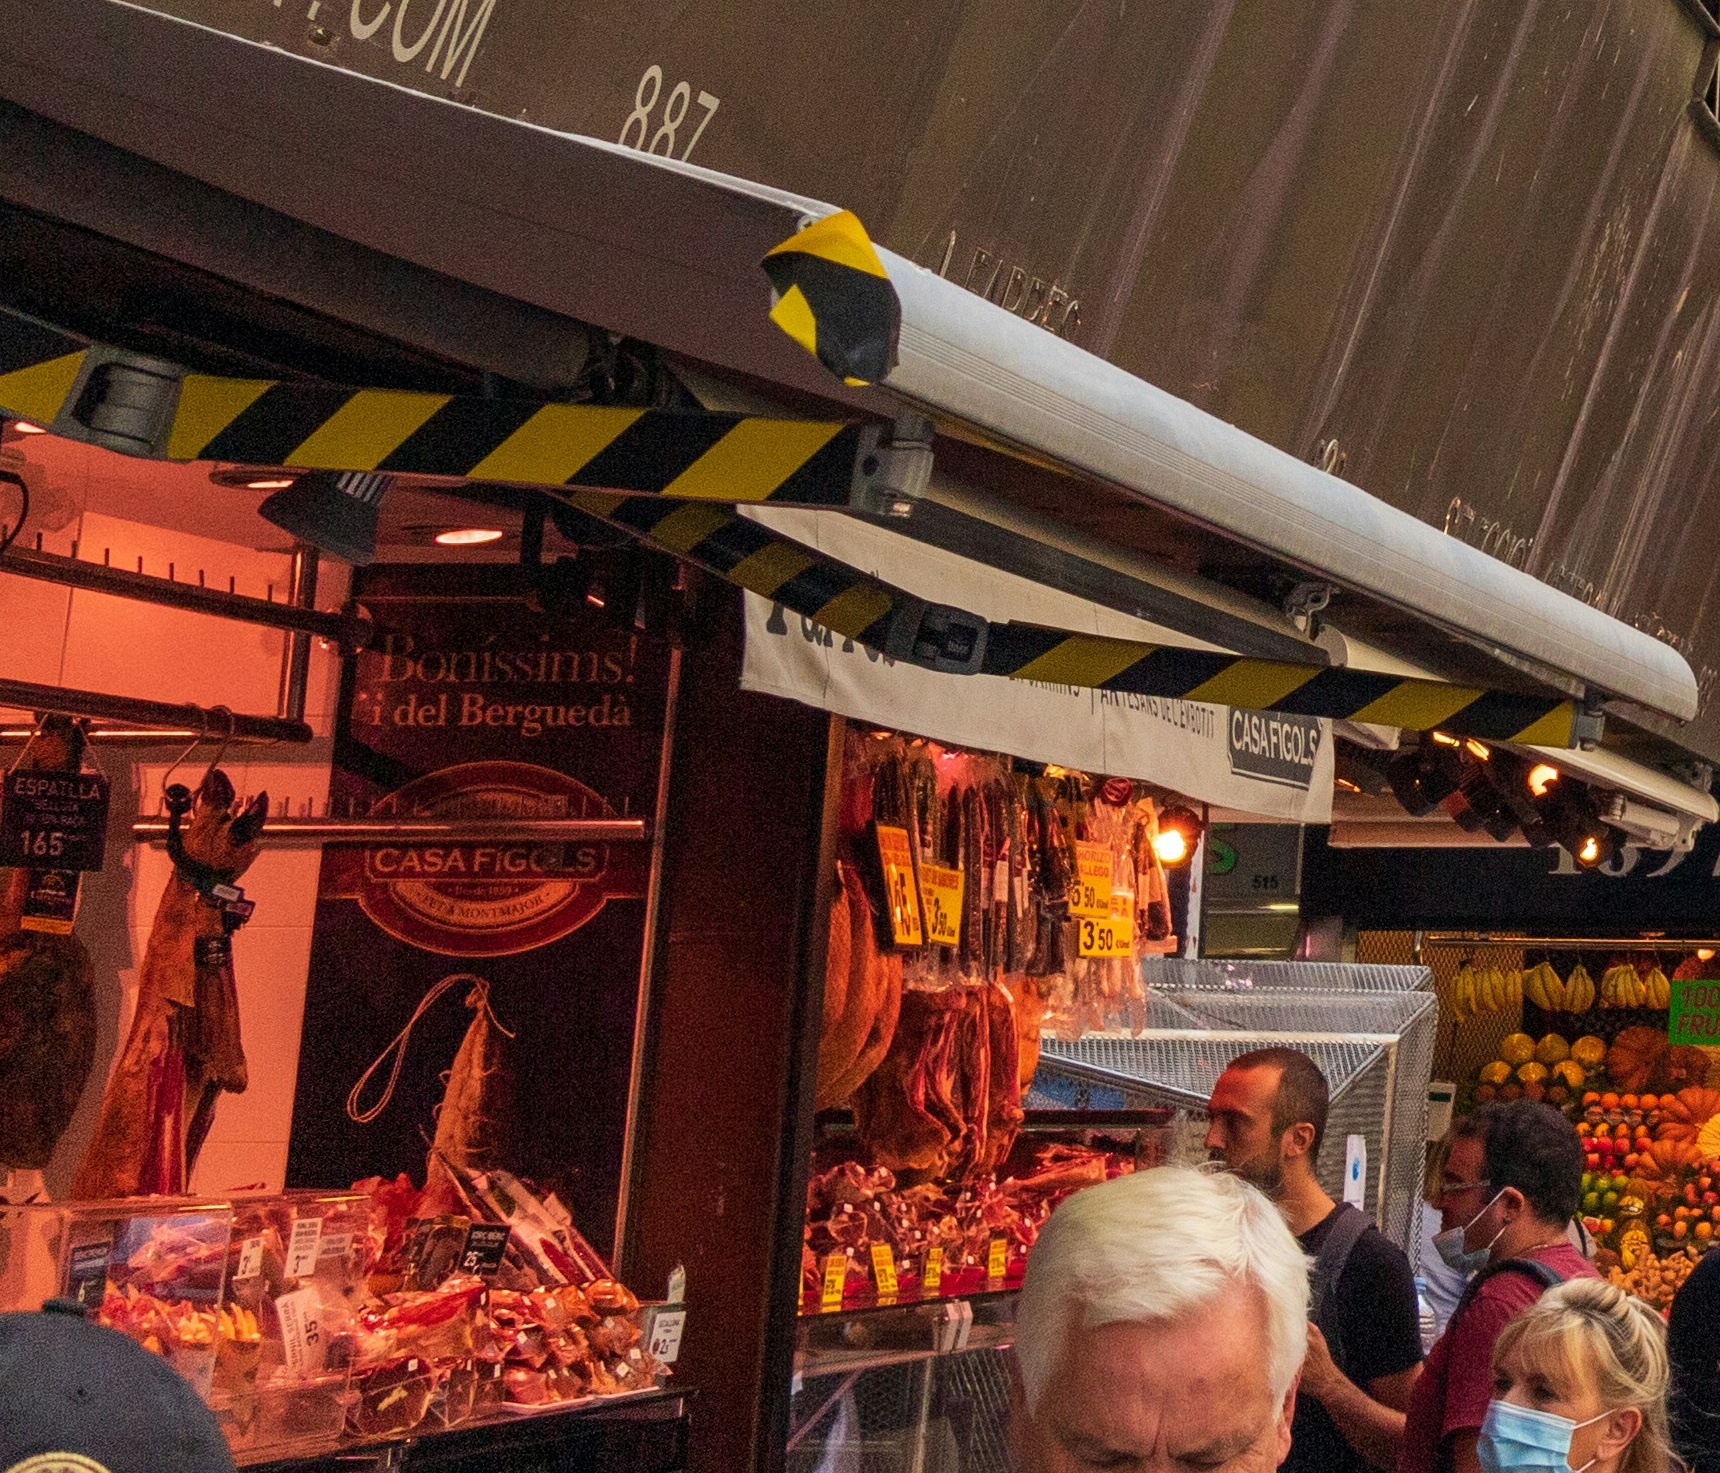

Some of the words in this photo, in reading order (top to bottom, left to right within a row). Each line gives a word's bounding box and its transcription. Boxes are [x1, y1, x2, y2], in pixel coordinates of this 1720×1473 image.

[620, 65, 721, 161] 887
[394, 692, 448, 727] del
[460, 692, 632, 737] Berguedà
[1232, 709, 1270, 759] CASA
[20, 829, 64, 857] 165
[374, 847, 467, 873] CASA
